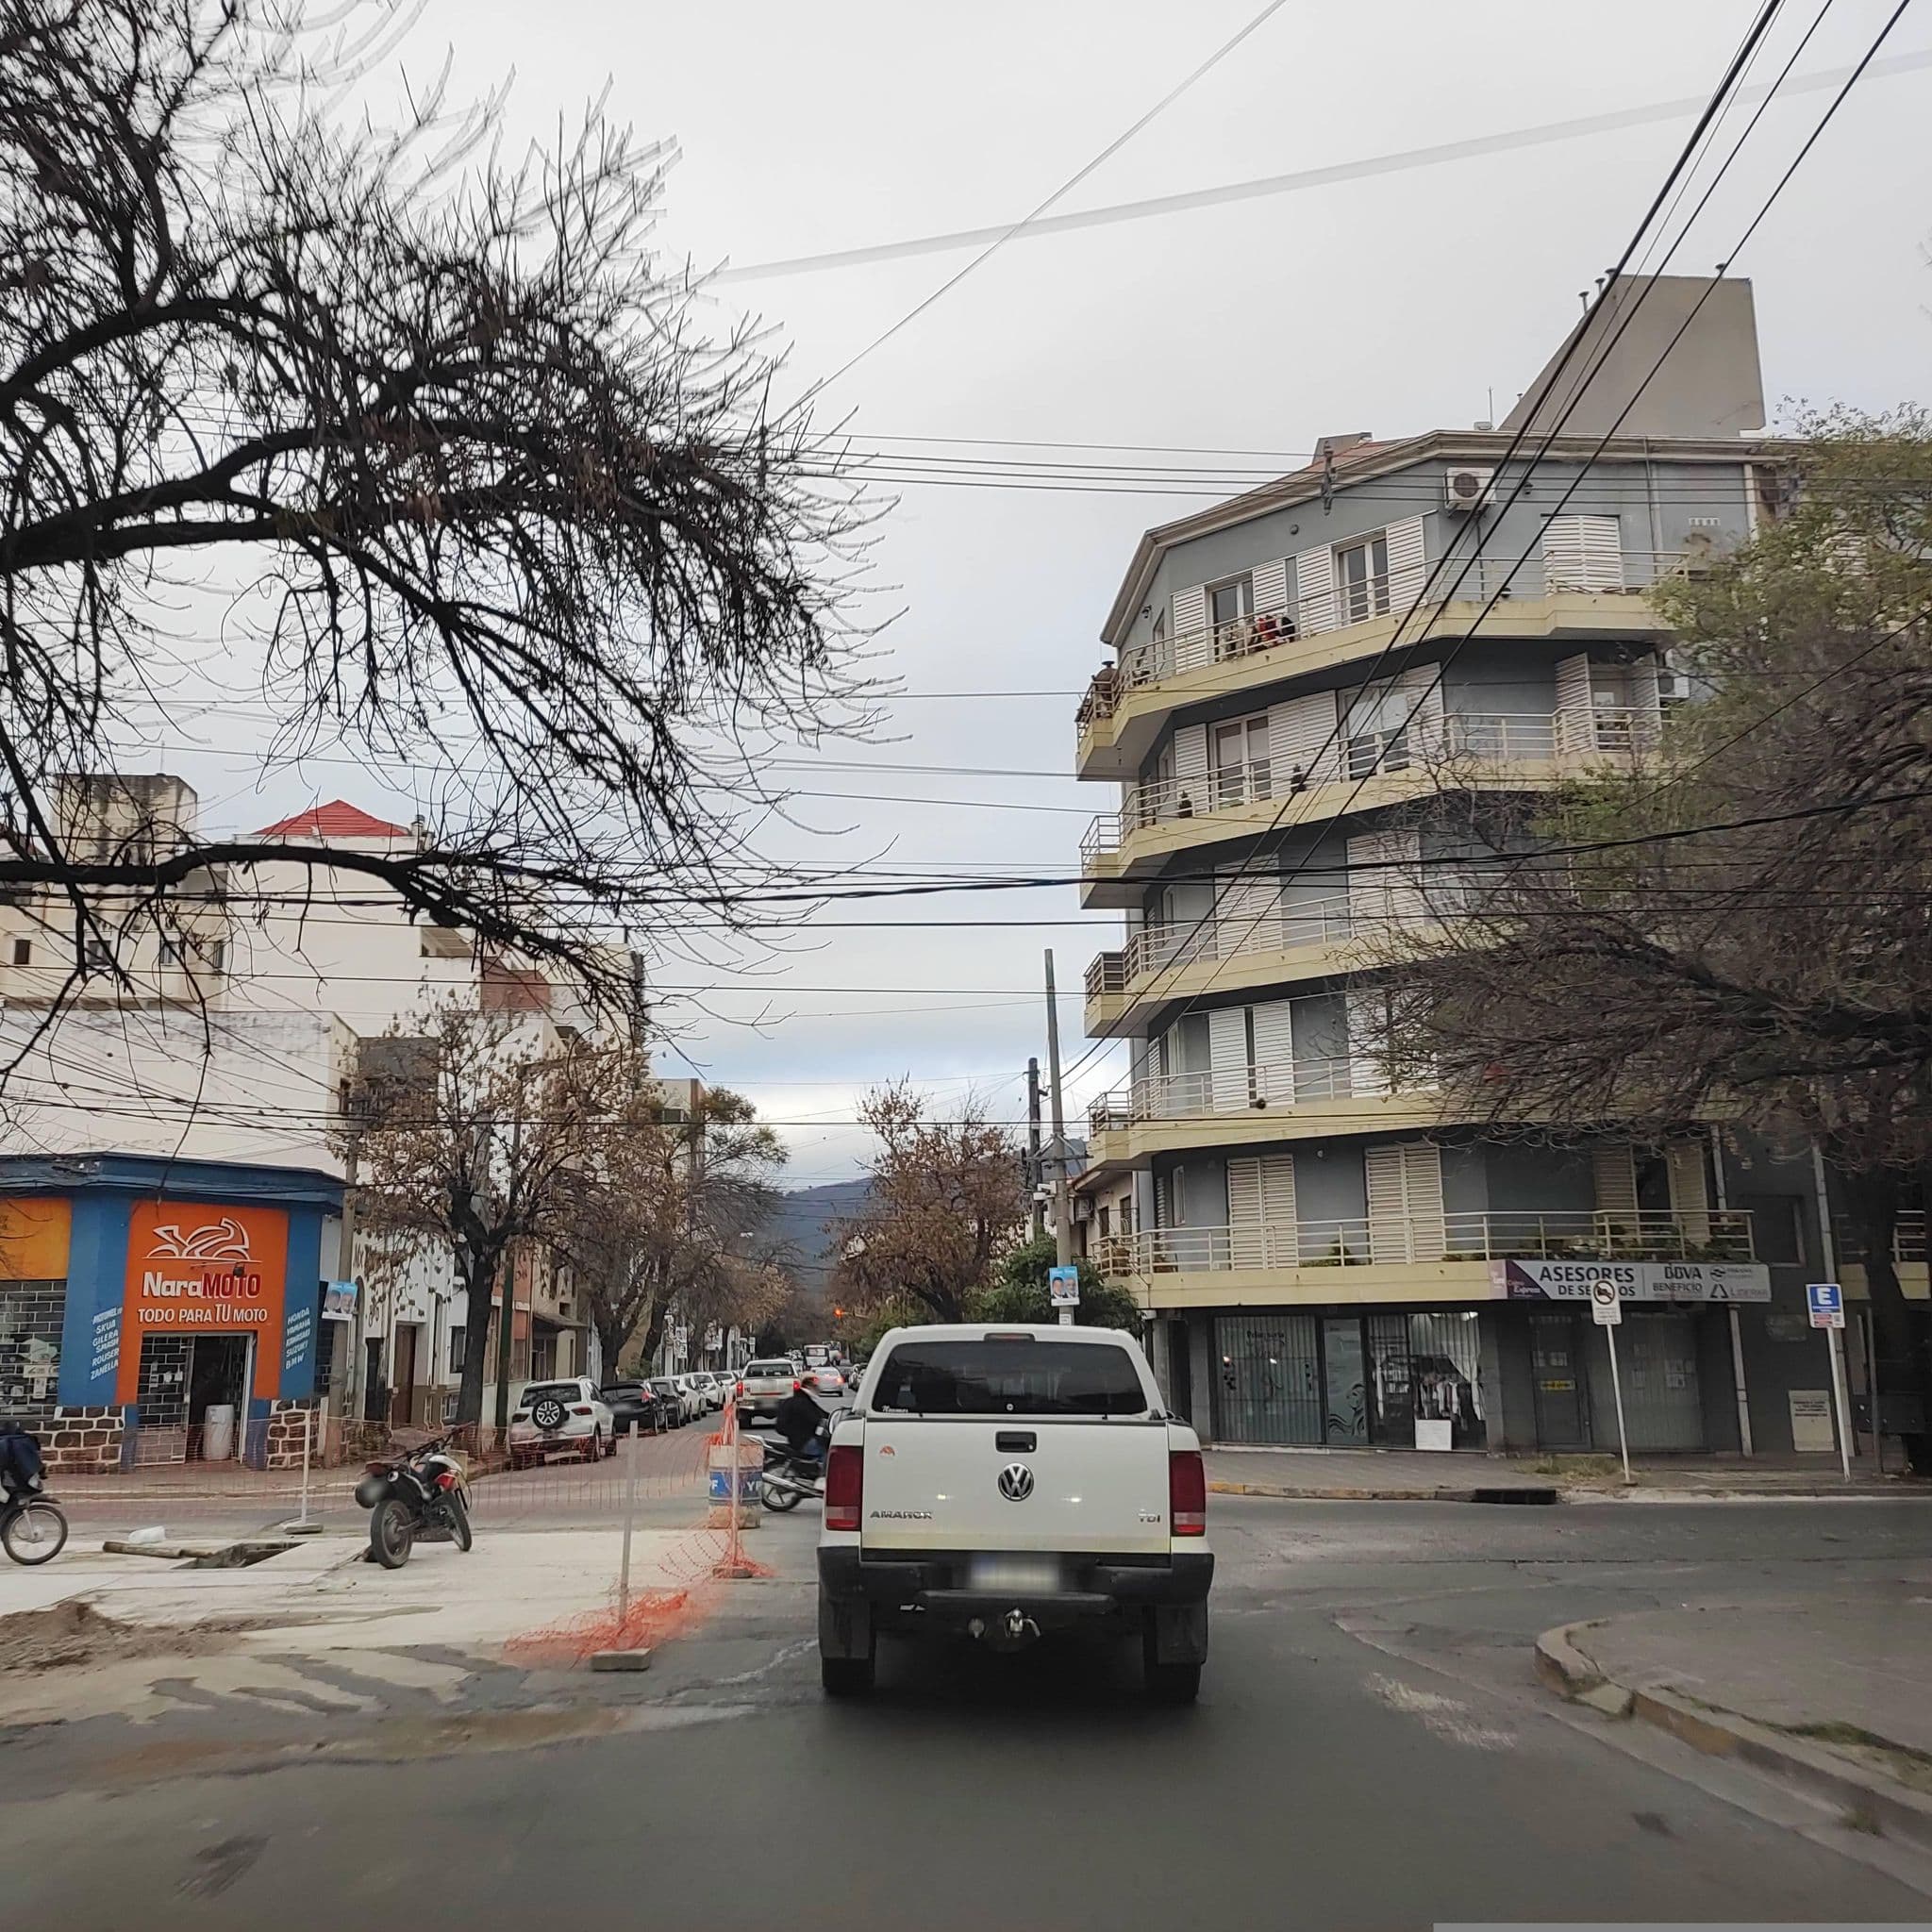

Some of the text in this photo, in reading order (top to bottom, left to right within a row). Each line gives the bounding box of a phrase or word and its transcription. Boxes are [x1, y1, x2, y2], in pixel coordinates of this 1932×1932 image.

[1540, 1266, 1635, 1283] ASESORES
[1664, 1266, 1703, 1279] BBVA
[142, 1271, 261, 1299] NaraMOTO
[1557, 1284, 1575, 1295] DE
[1817, 1287, 1833, 1305] E
[138, 1307, 175, 1323] TODO
[178, 1307, 212, 1323] PARA
[214, 1303, 231, 1323] TU
[233, 1307, 268, 1323] MOTO
[287, 1307, 310, 1325] HONDA
[92, 1329, 119, 1347] GILERA
[92, 1347, 120, 1367] ROUSER
[285, 1352, 305, 1370] BMW
[90, 1358, 119, 1381] ZANELLA
[870, 1509, 933, 1520] AMAROK
[1138, 1512, 1161, 1524] TDI
